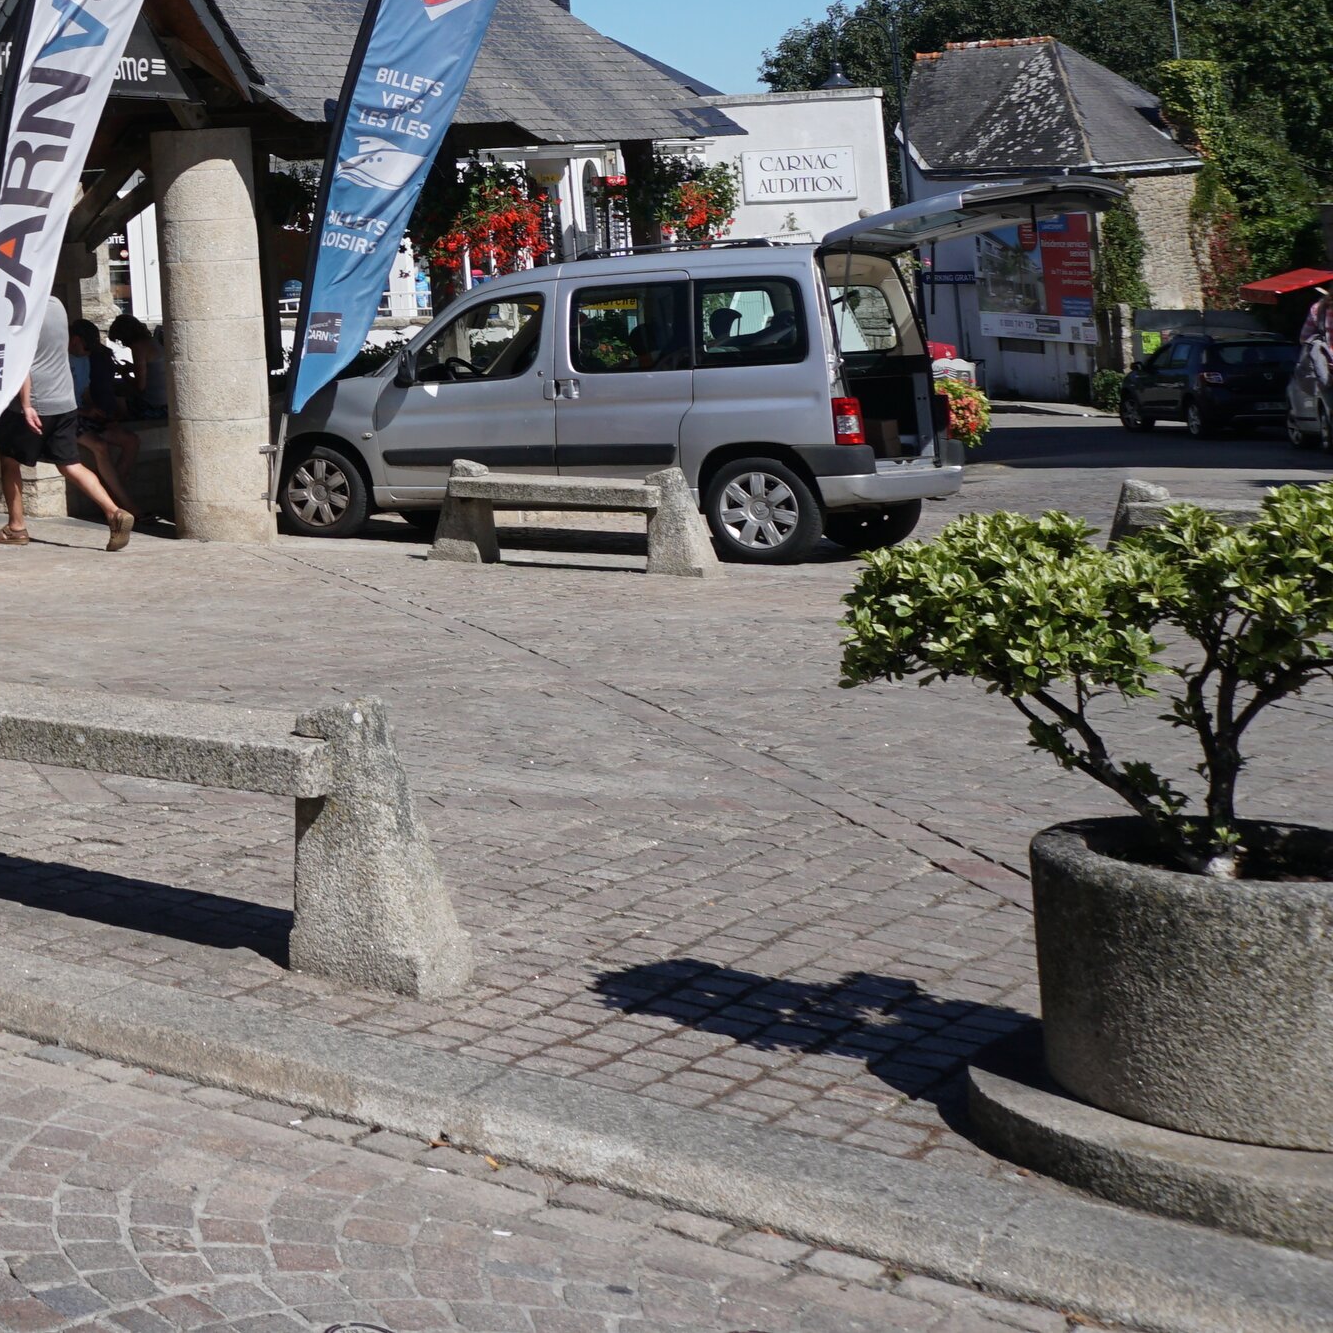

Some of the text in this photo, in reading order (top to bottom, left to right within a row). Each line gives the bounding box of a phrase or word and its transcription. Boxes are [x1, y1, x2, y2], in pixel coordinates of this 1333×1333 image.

[375, 67, 445, 97] BILLETS
[382, 91, 425, 114] VERS
[359, 109, 389, 128] LES
[759, 154, 838, 172] CARNAC
[758, 176, 843, 194] AUDITION
[328, 210, 389, 236] BILLETS
[321, 231, 379, 255] LOISIRS
